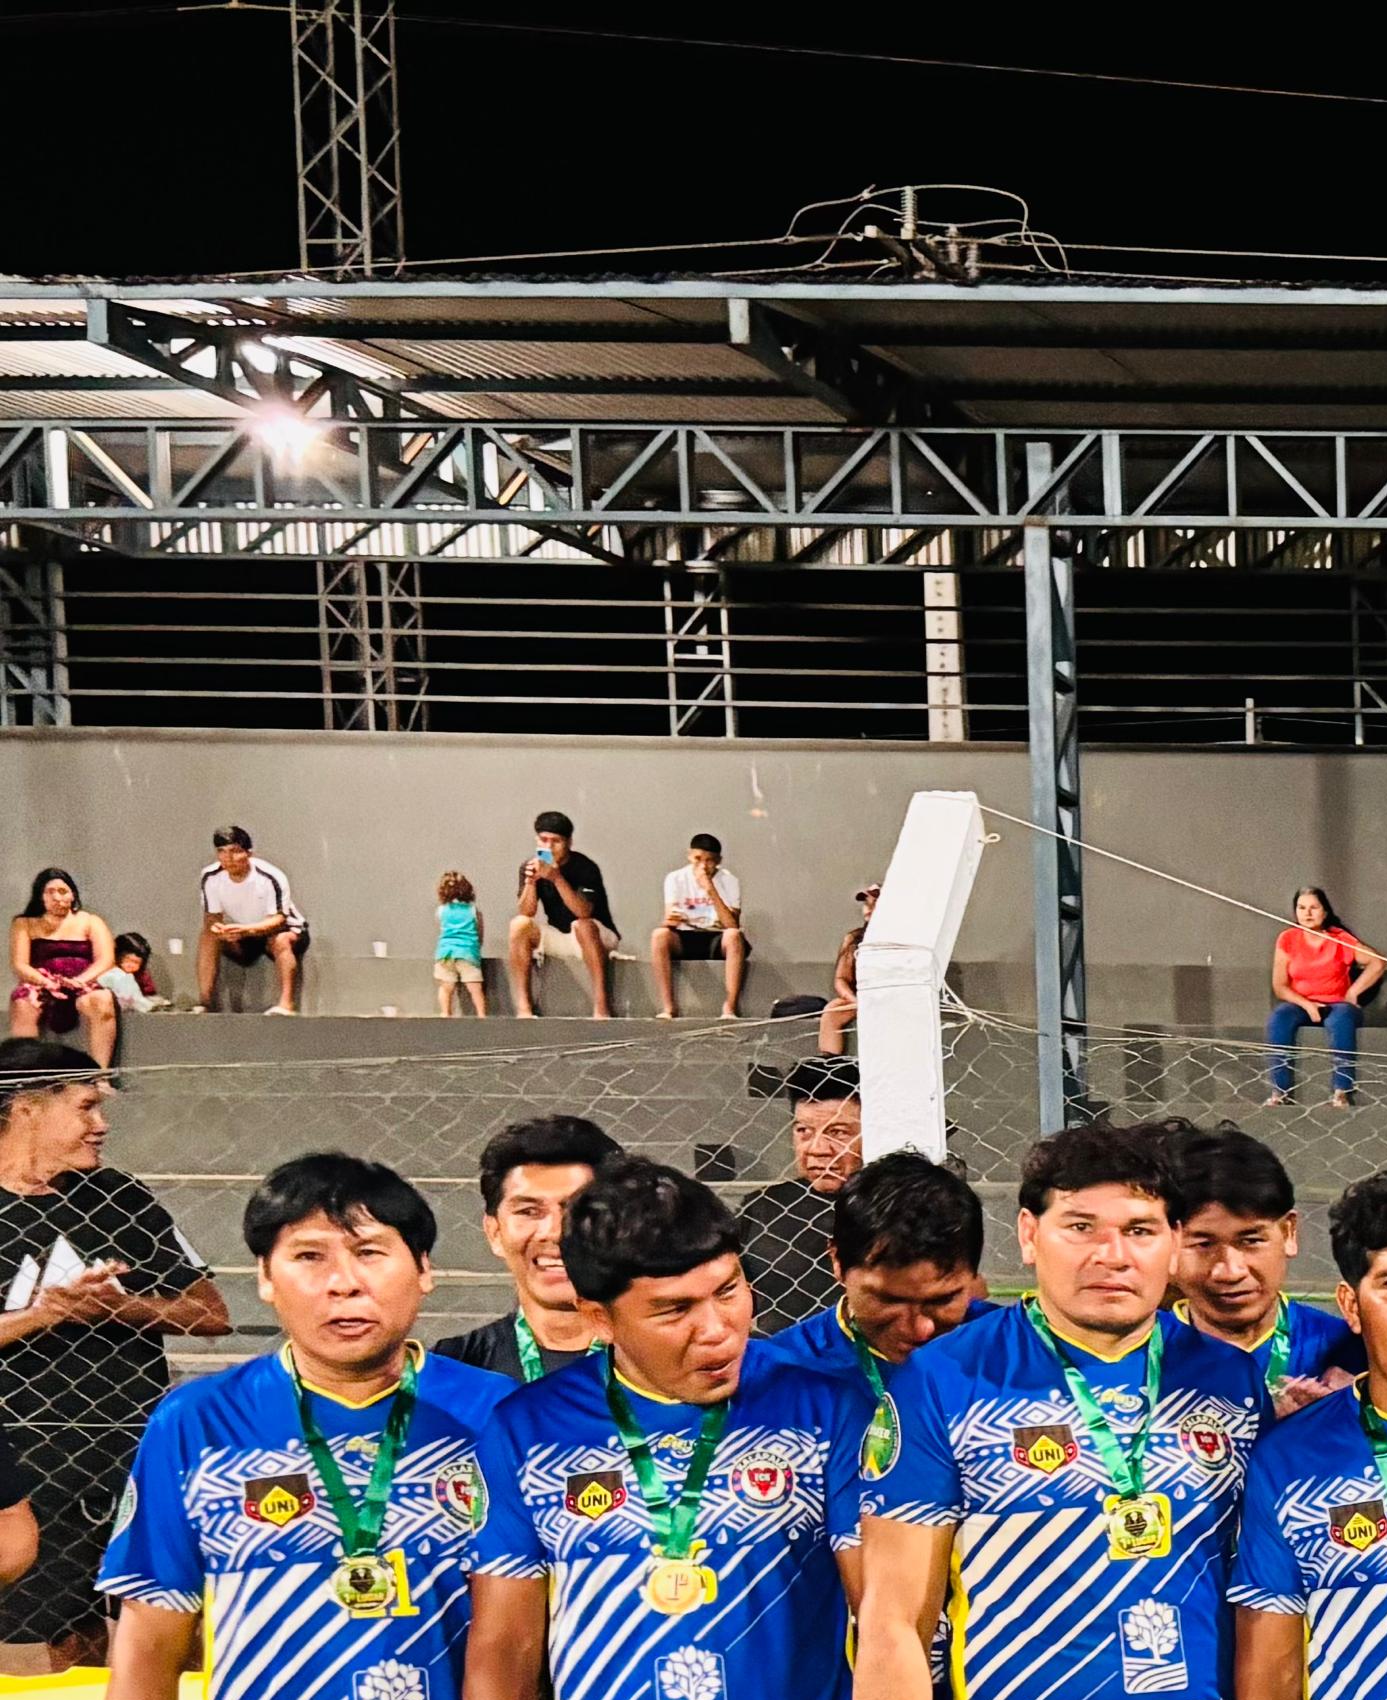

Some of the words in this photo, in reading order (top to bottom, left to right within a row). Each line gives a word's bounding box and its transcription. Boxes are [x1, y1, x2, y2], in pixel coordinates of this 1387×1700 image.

[1033, 1447, 1061, 1463] UNI
[264, 1499, 295, 1515] UNI
[581, 1494, 609, 1508] UNI
[1347, 1525, 1374, 1541] UNI
